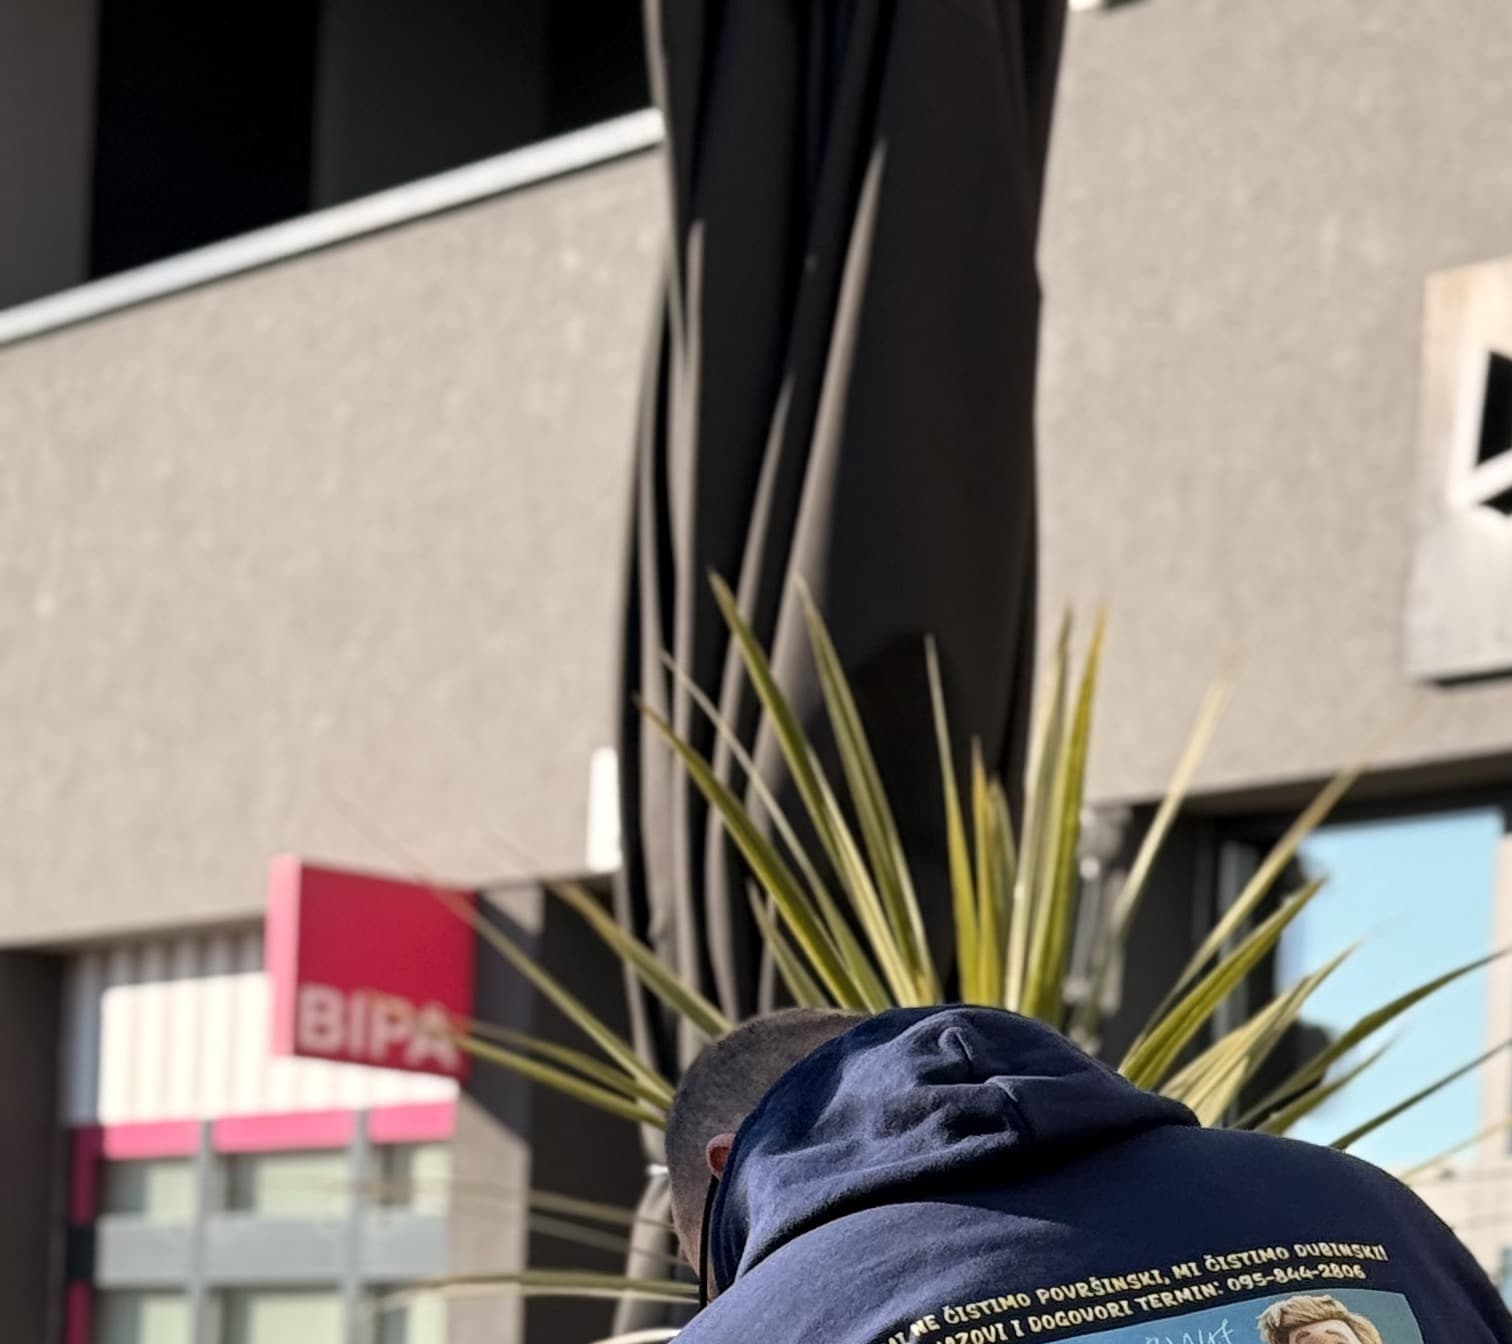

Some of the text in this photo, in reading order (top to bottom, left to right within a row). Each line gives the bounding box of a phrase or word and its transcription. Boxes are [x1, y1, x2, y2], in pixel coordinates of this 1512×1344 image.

[298, 982, 461, 1073] BIPA
[910, 1314, 940, 1337] NE
[943, 1292, 1031, 1325] ČISTIMO
[1036, 1268, 1171, 1305] POVRŠINSKI,
[1172, 1261, 1202, 1280] MI
[1204, 1246, 1290, 1272] ČISTIMO
[1294, 1242, 1388, 1261] DUBINSKI!
[1010, 1320, 1025, 1337] I
[1028, 1301, 1133, 1333] DOGOVORI
[1134, 1281, 1223, 1312] TERMIN:
[1227, 1263, 1366, 1292] 095-844-2806
